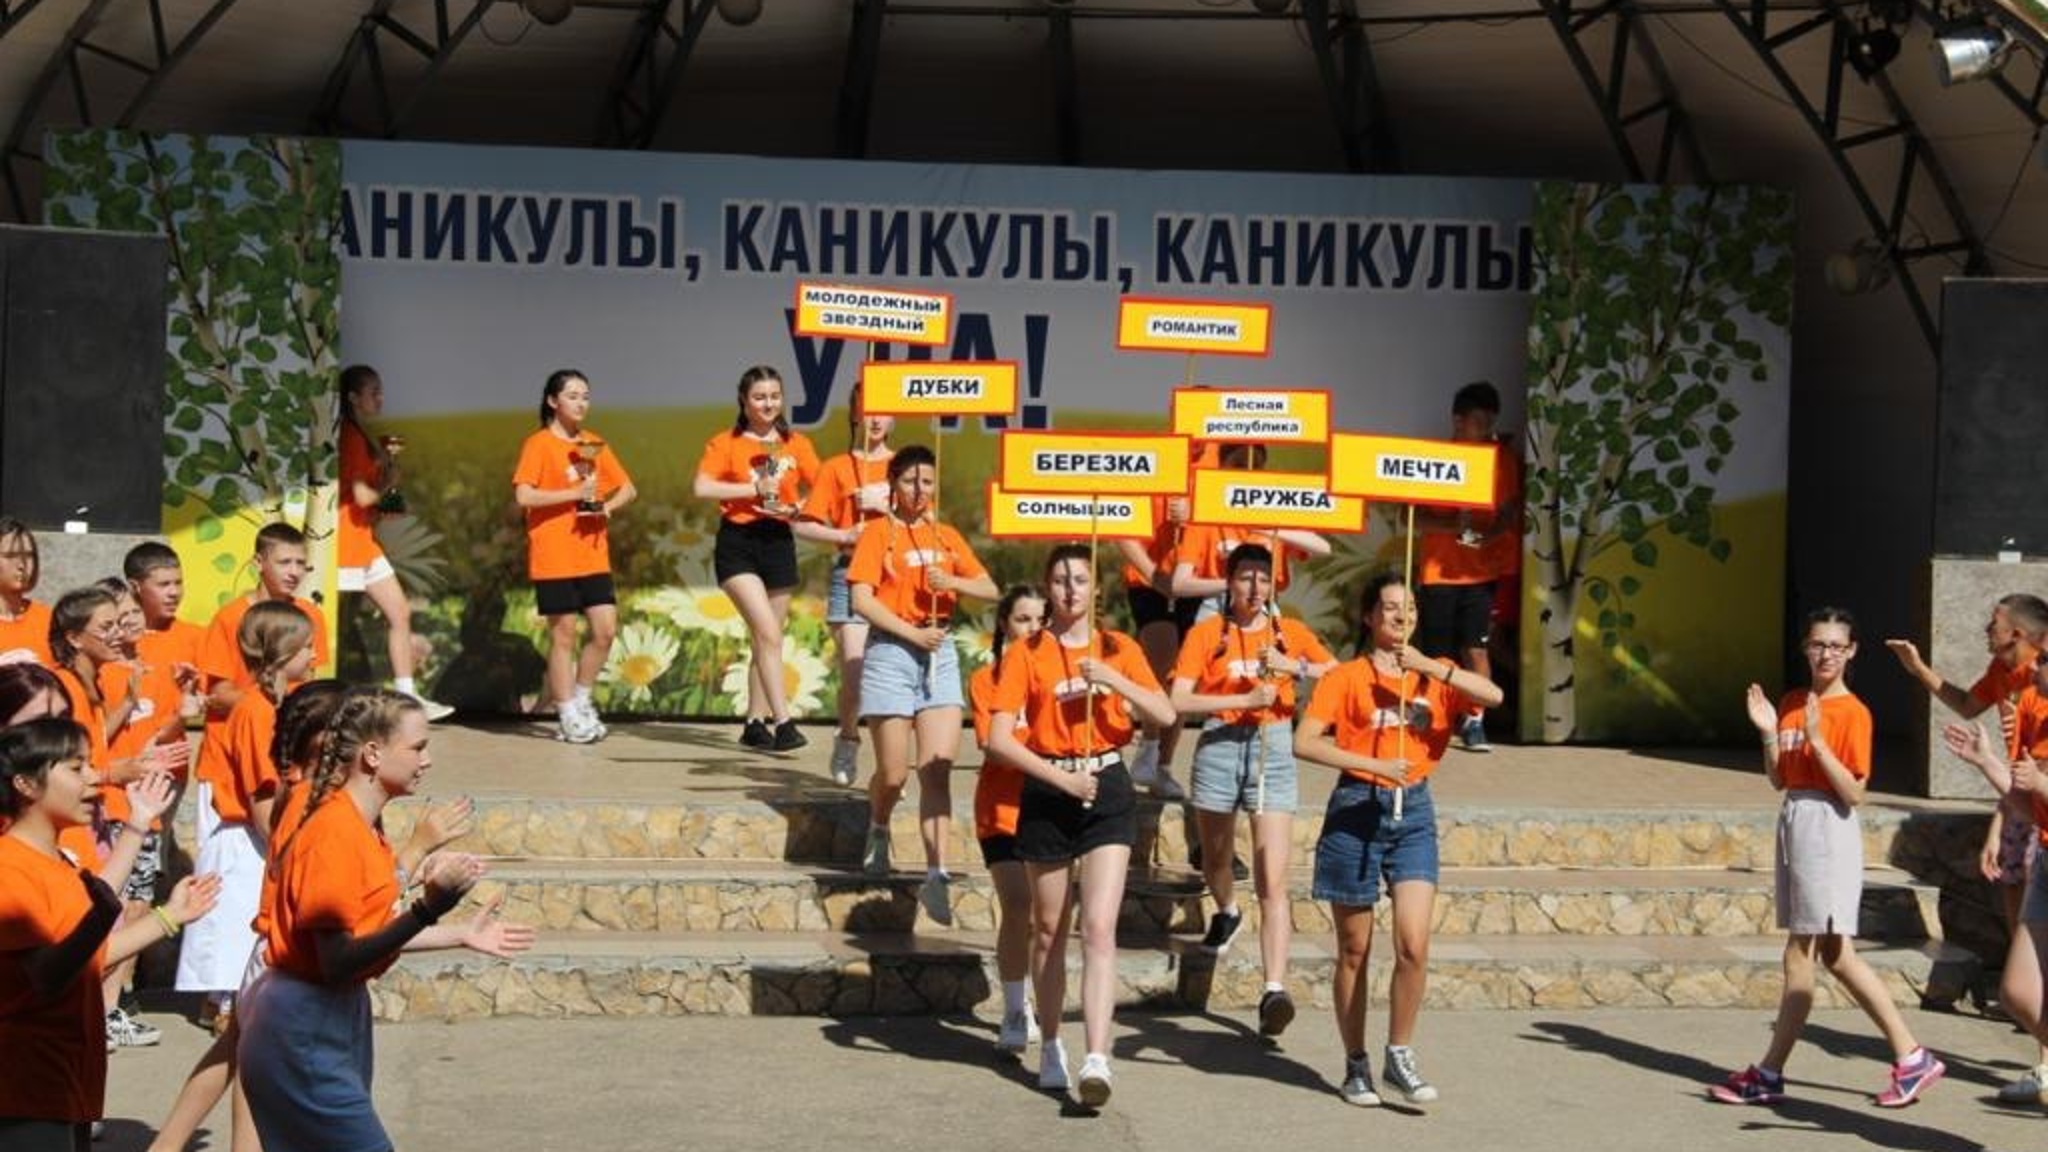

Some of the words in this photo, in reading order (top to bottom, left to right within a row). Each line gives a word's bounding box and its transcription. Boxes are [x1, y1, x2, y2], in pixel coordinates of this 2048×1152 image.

[725, 204, 1132, 293] КАНИКУЛЫ,
[1156, 217, 1533, 291] КАНИКУЛЫ
[822, 312, 925, 331] звездный
[1152, 320, 1237, 336] РОМАНТИК
[785, 308, 1050, 428] УА!
[907, 379, 980, 396] ДУБКИ
[1226, 397, 1284, 410] Лесная
[1206, 420, 1299, 434] республика
[1036, 453, 1151, 473] БЕРЕЗКА
[1382, 457, 1461, 482] МЕЧТА
[1230, 488, 1331, 509] ДРУЖБА
